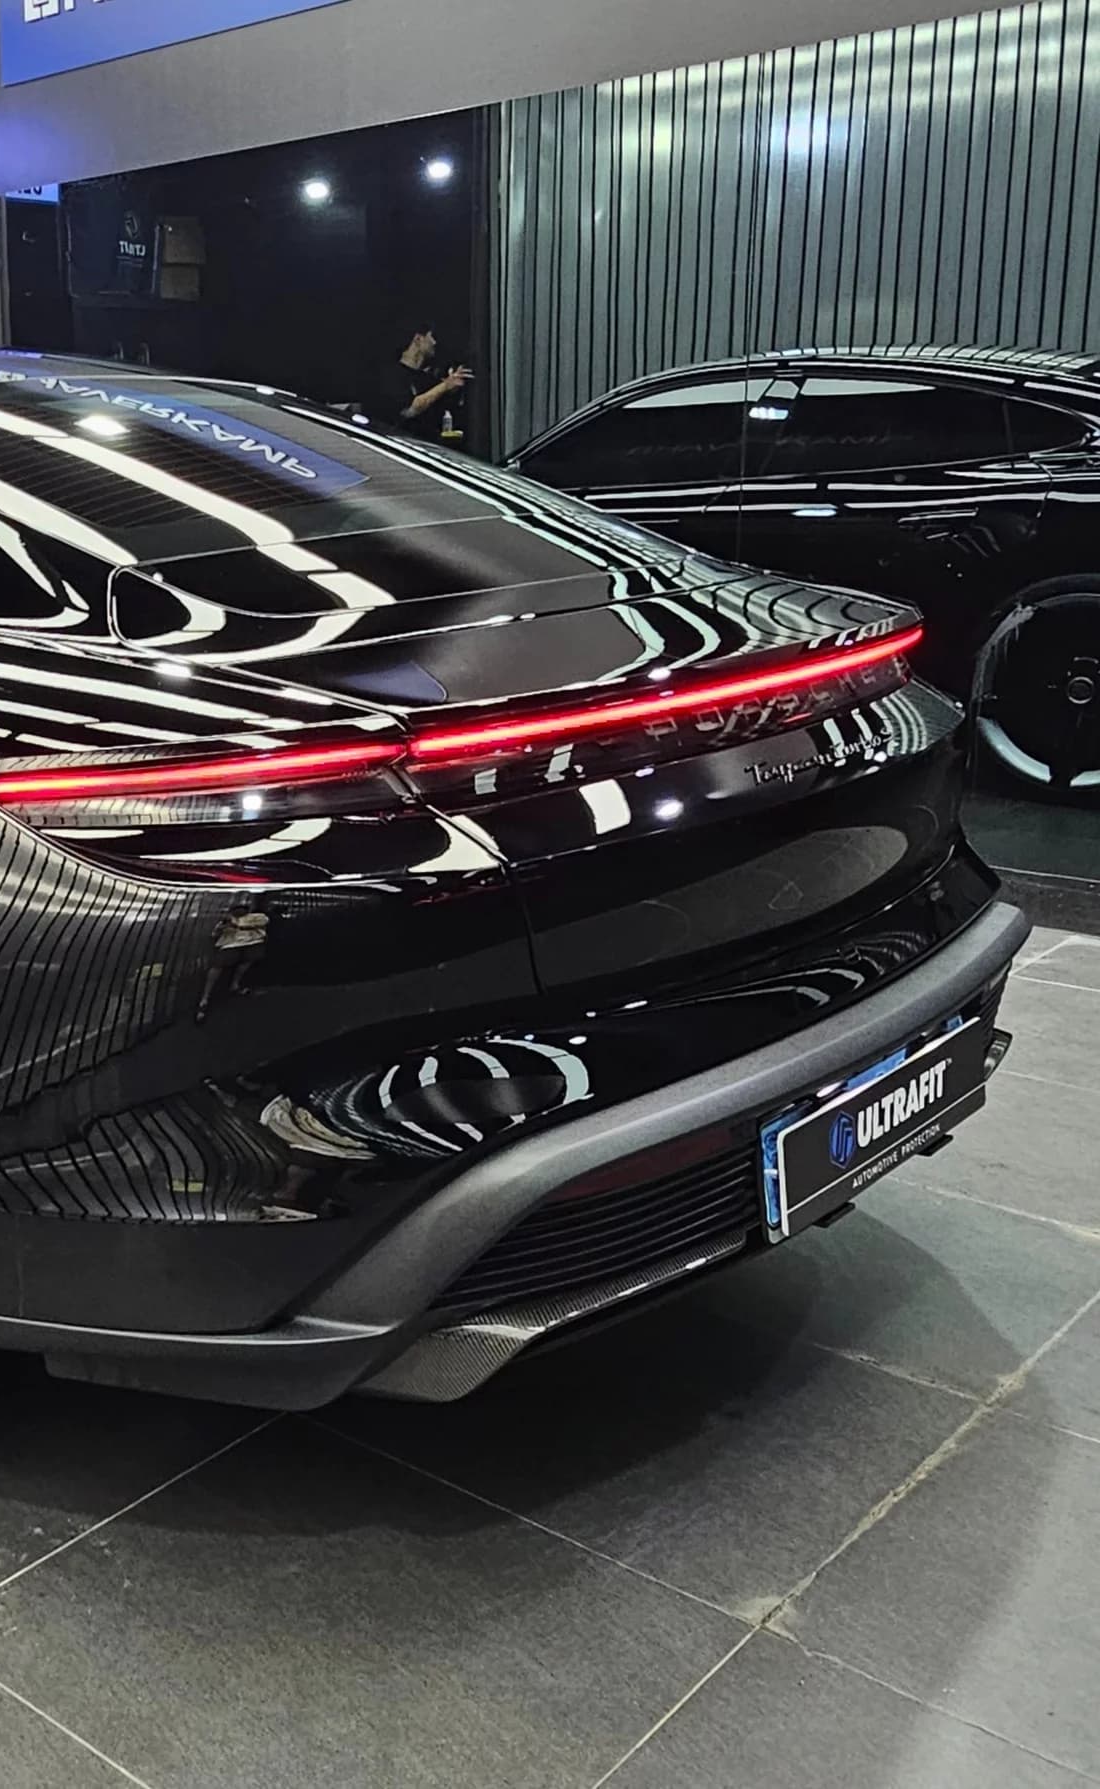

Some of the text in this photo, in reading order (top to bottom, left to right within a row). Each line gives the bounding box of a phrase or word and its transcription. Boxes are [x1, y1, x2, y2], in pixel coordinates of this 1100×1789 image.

[856, 1060, 947, 1148] ULTRAFIT
[852, 1123, 941, 1189] AUTOMOTIVE PROTECTION
